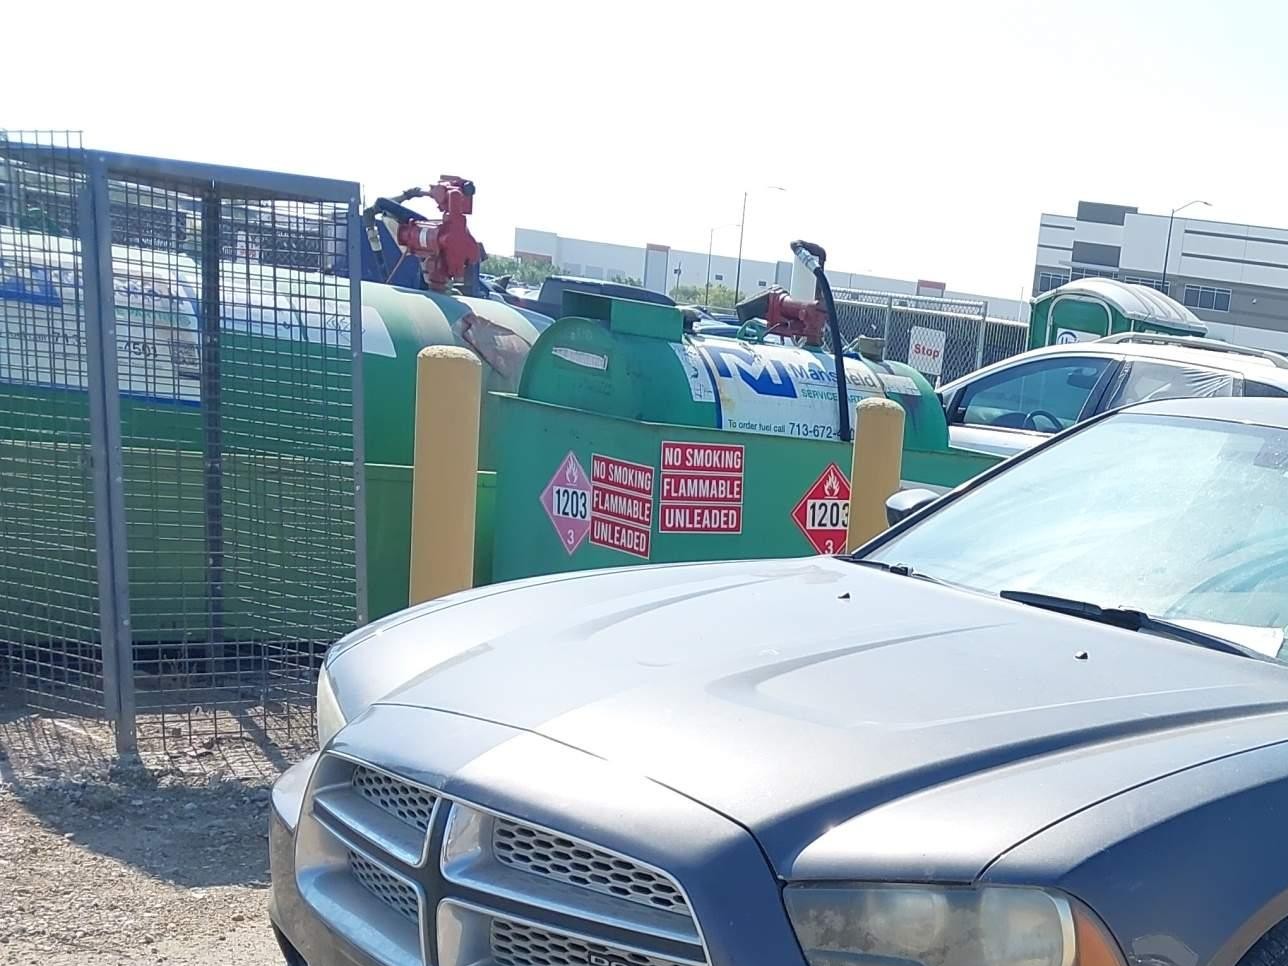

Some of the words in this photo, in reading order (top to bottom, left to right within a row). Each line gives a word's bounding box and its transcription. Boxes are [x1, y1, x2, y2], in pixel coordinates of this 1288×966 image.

[914, 343, 940, 361] Stop
[790, 362, 877, 388] Mansield
[801, 388, 838, 401] SERVICE
[728, 419, 737, 428] To
[739, 420, 757, 430] order
[773, 424, 786, 433] call
[664, 447, 682, 466] NO
[685, 448, 742, 469] SMOKING
[593, 460, 606, 480] NO
[608, 465, 651, 491] SMOKING
[663, 478, 741, 499] FLAMMABLE
[555, 488, 588, 520] 1203
[592, 489, 651, 522] FLAMMABLE
[665, 508, 737, 529] UNLEADED
[809, 502, 850, 528] 1203
[566, 529, 575, 545] 3
[593, 522, 646, 553] UNLEADED
[824, 539, 834, 555] 3
